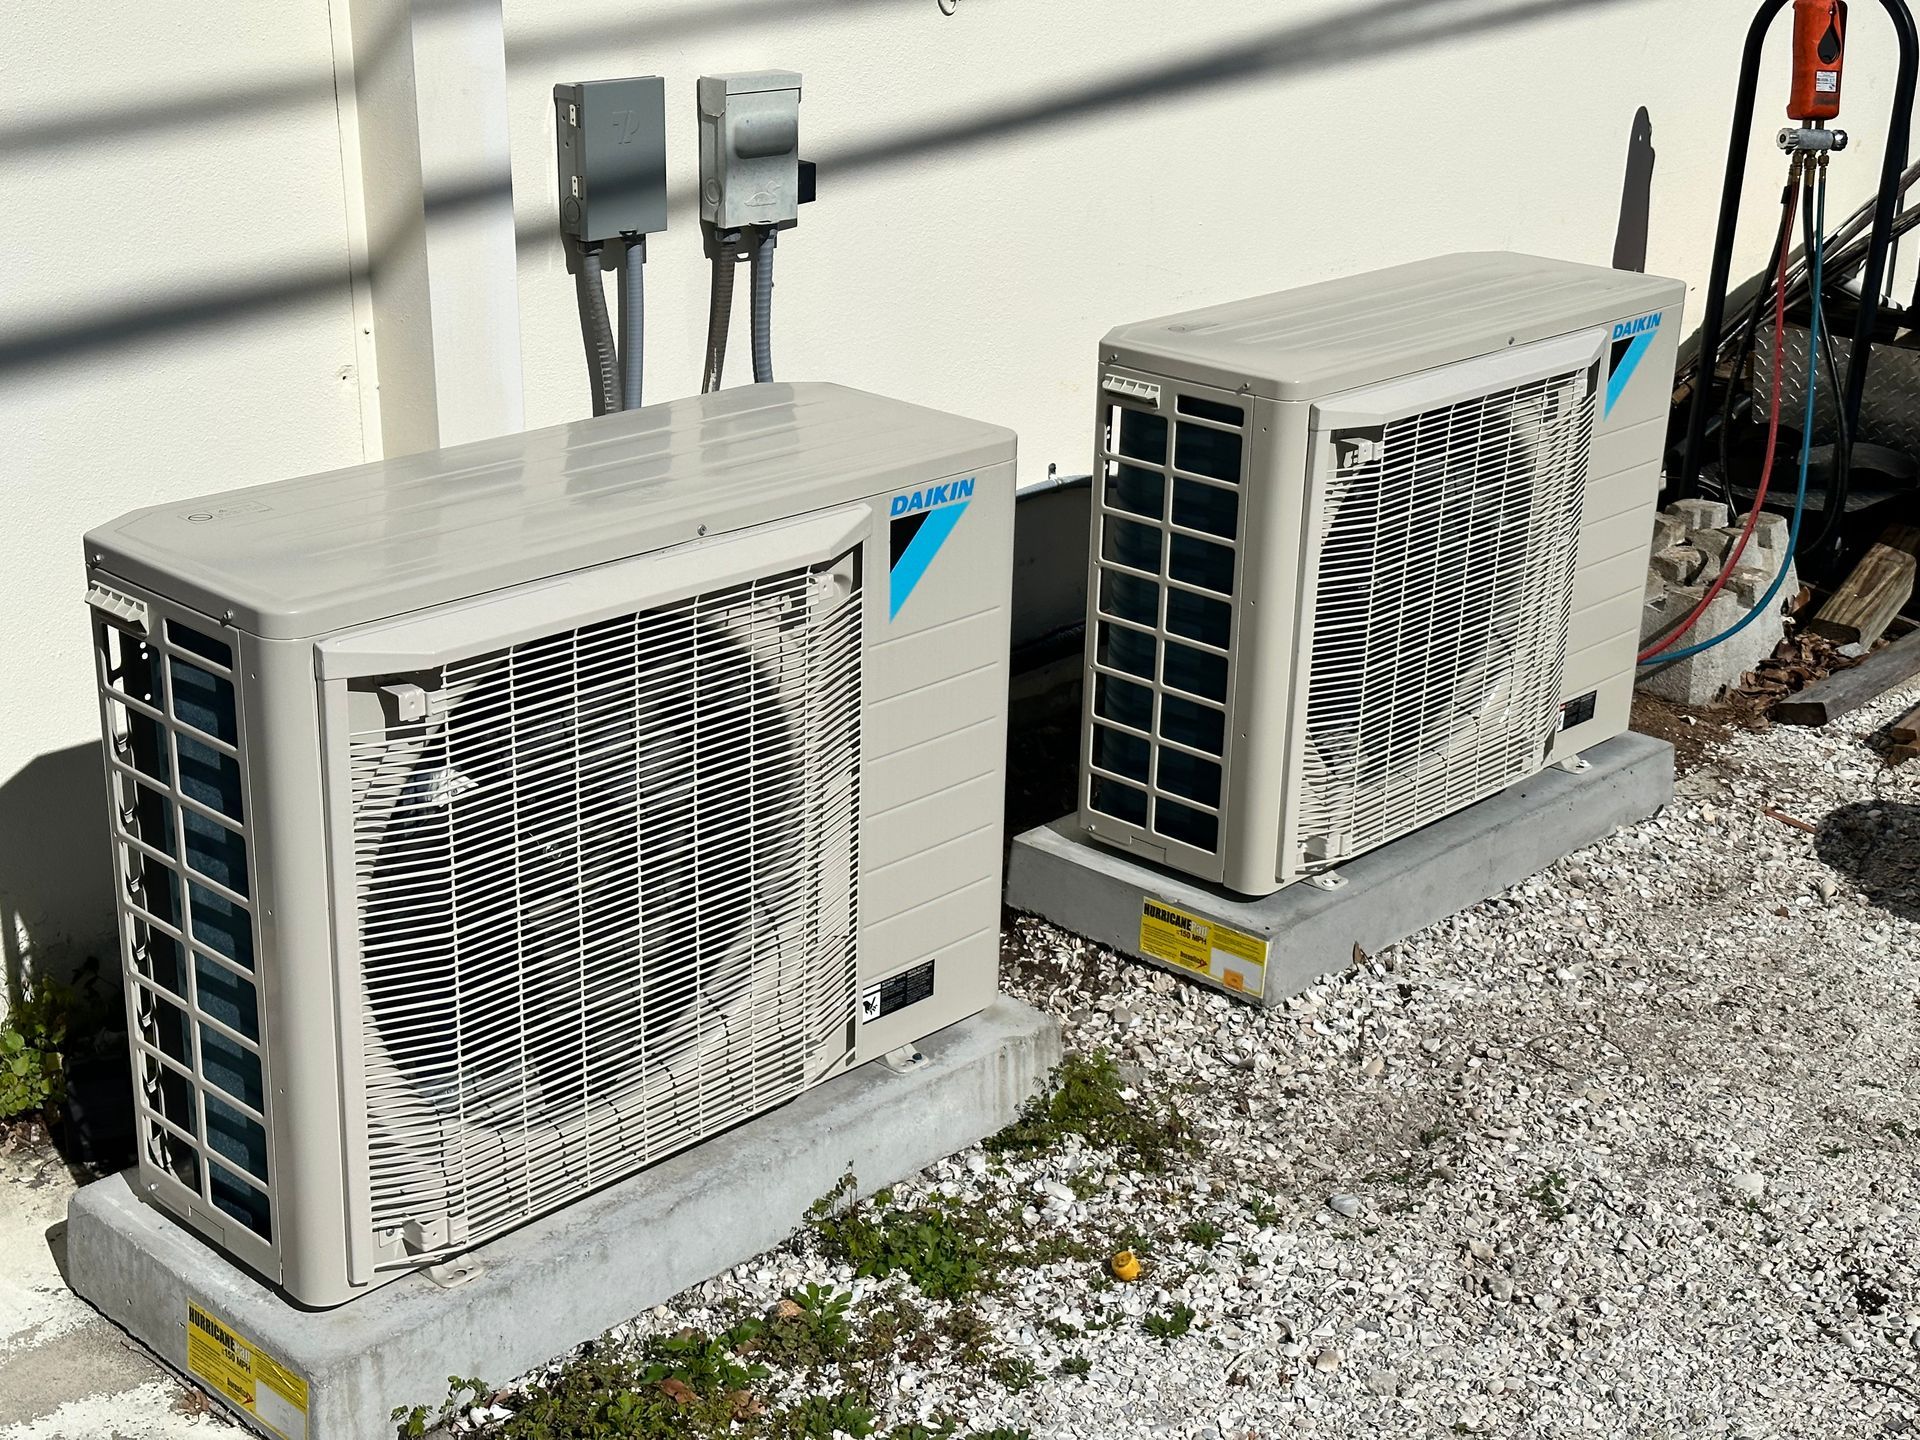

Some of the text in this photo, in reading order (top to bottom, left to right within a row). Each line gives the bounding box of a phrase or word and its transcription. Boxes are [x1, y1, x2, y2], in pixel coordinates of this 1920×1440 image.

[1612, 312, 1662, 340] DAIKIN
[890, 477, 976, 517] DAIKIN
[1192, 933, 1207, 945] MPH
[236, 1356, 251, 1374] MPH
